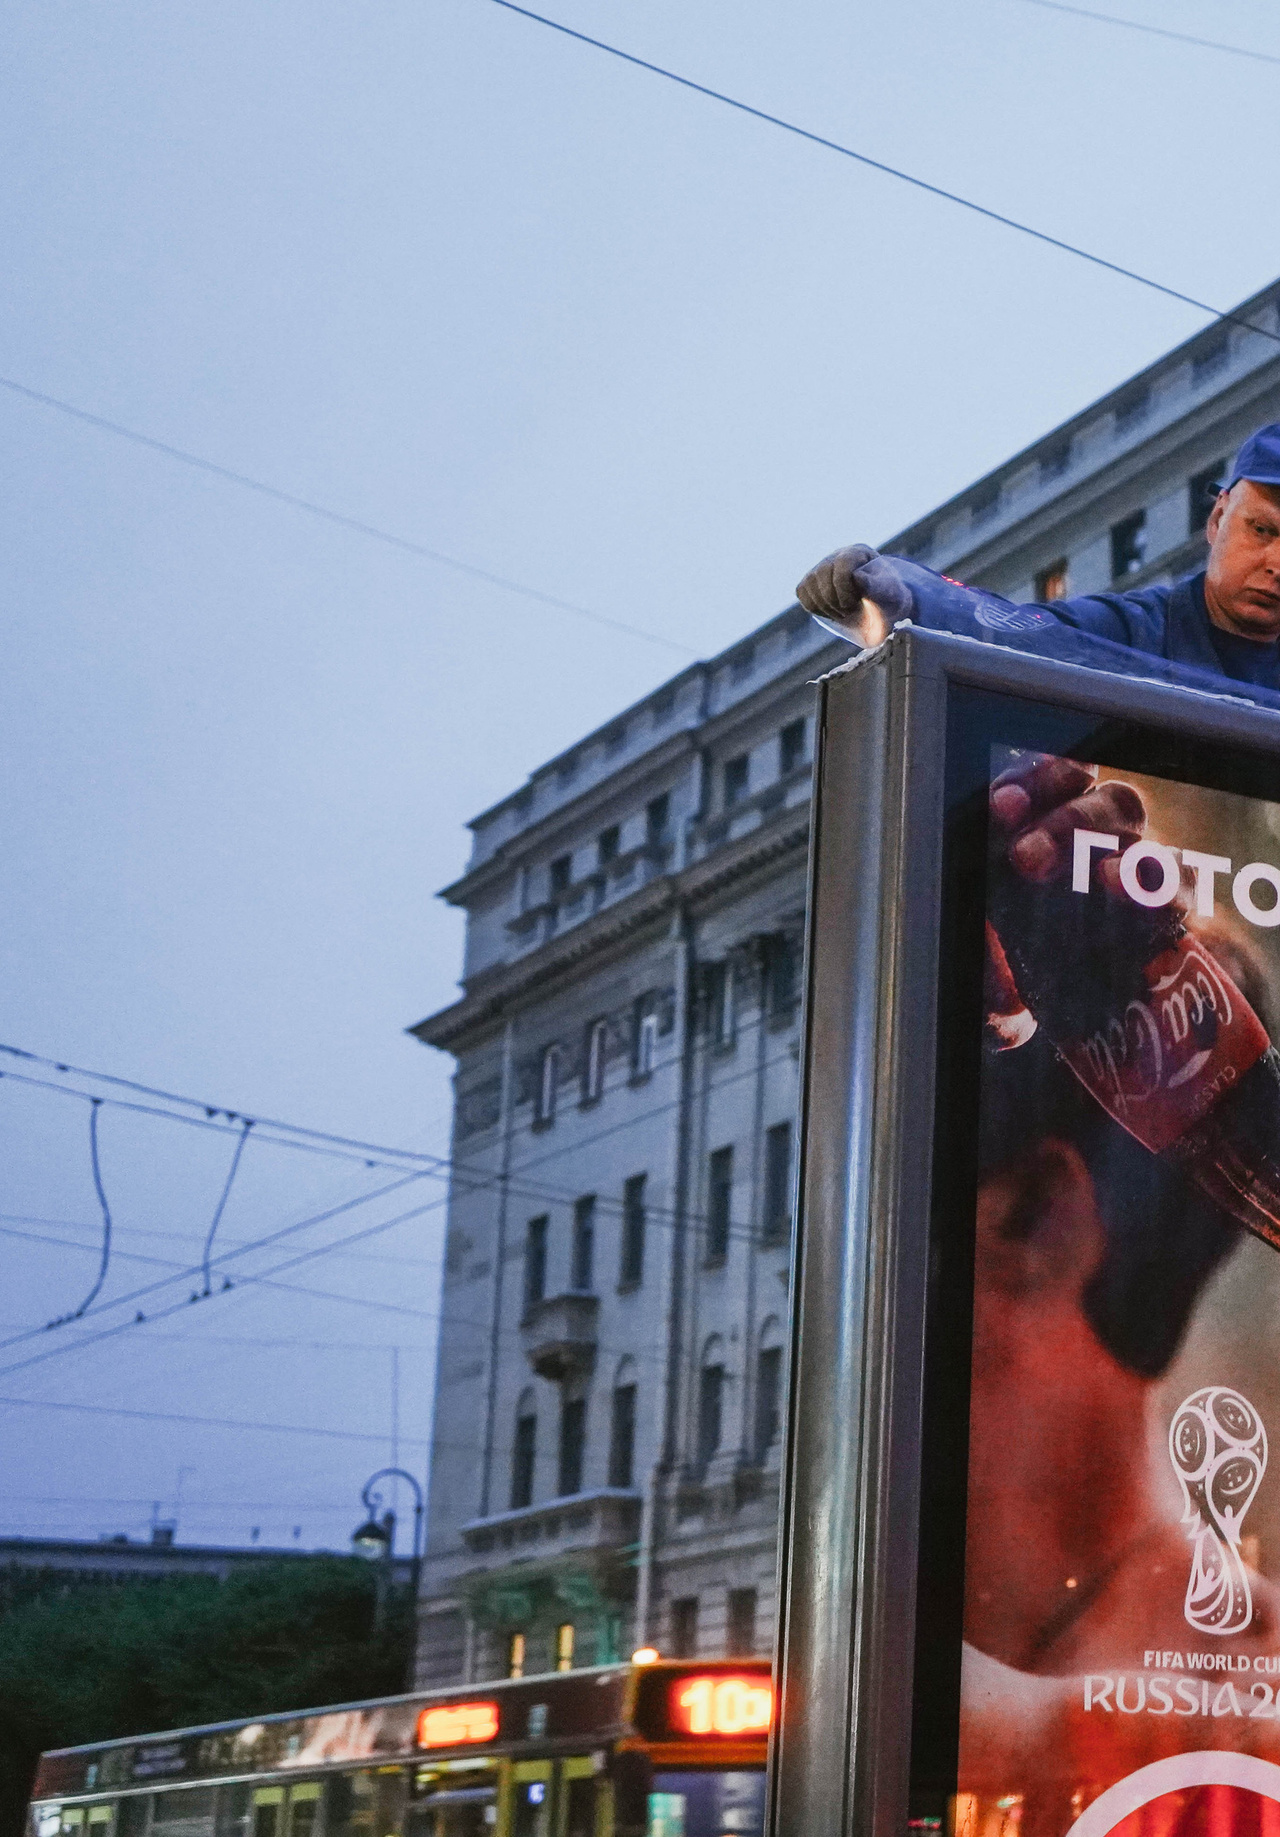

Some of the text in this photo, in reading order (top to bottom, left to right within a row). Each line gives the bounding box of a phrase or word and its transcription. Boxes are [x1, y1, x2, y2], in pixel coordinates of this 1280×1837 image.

[1144, 1650, 1185, 1669] FIFA
[1186, 1652, 1250, 1672] WORLD
[1083, 1674, 1243, 1718] RUSSIA
